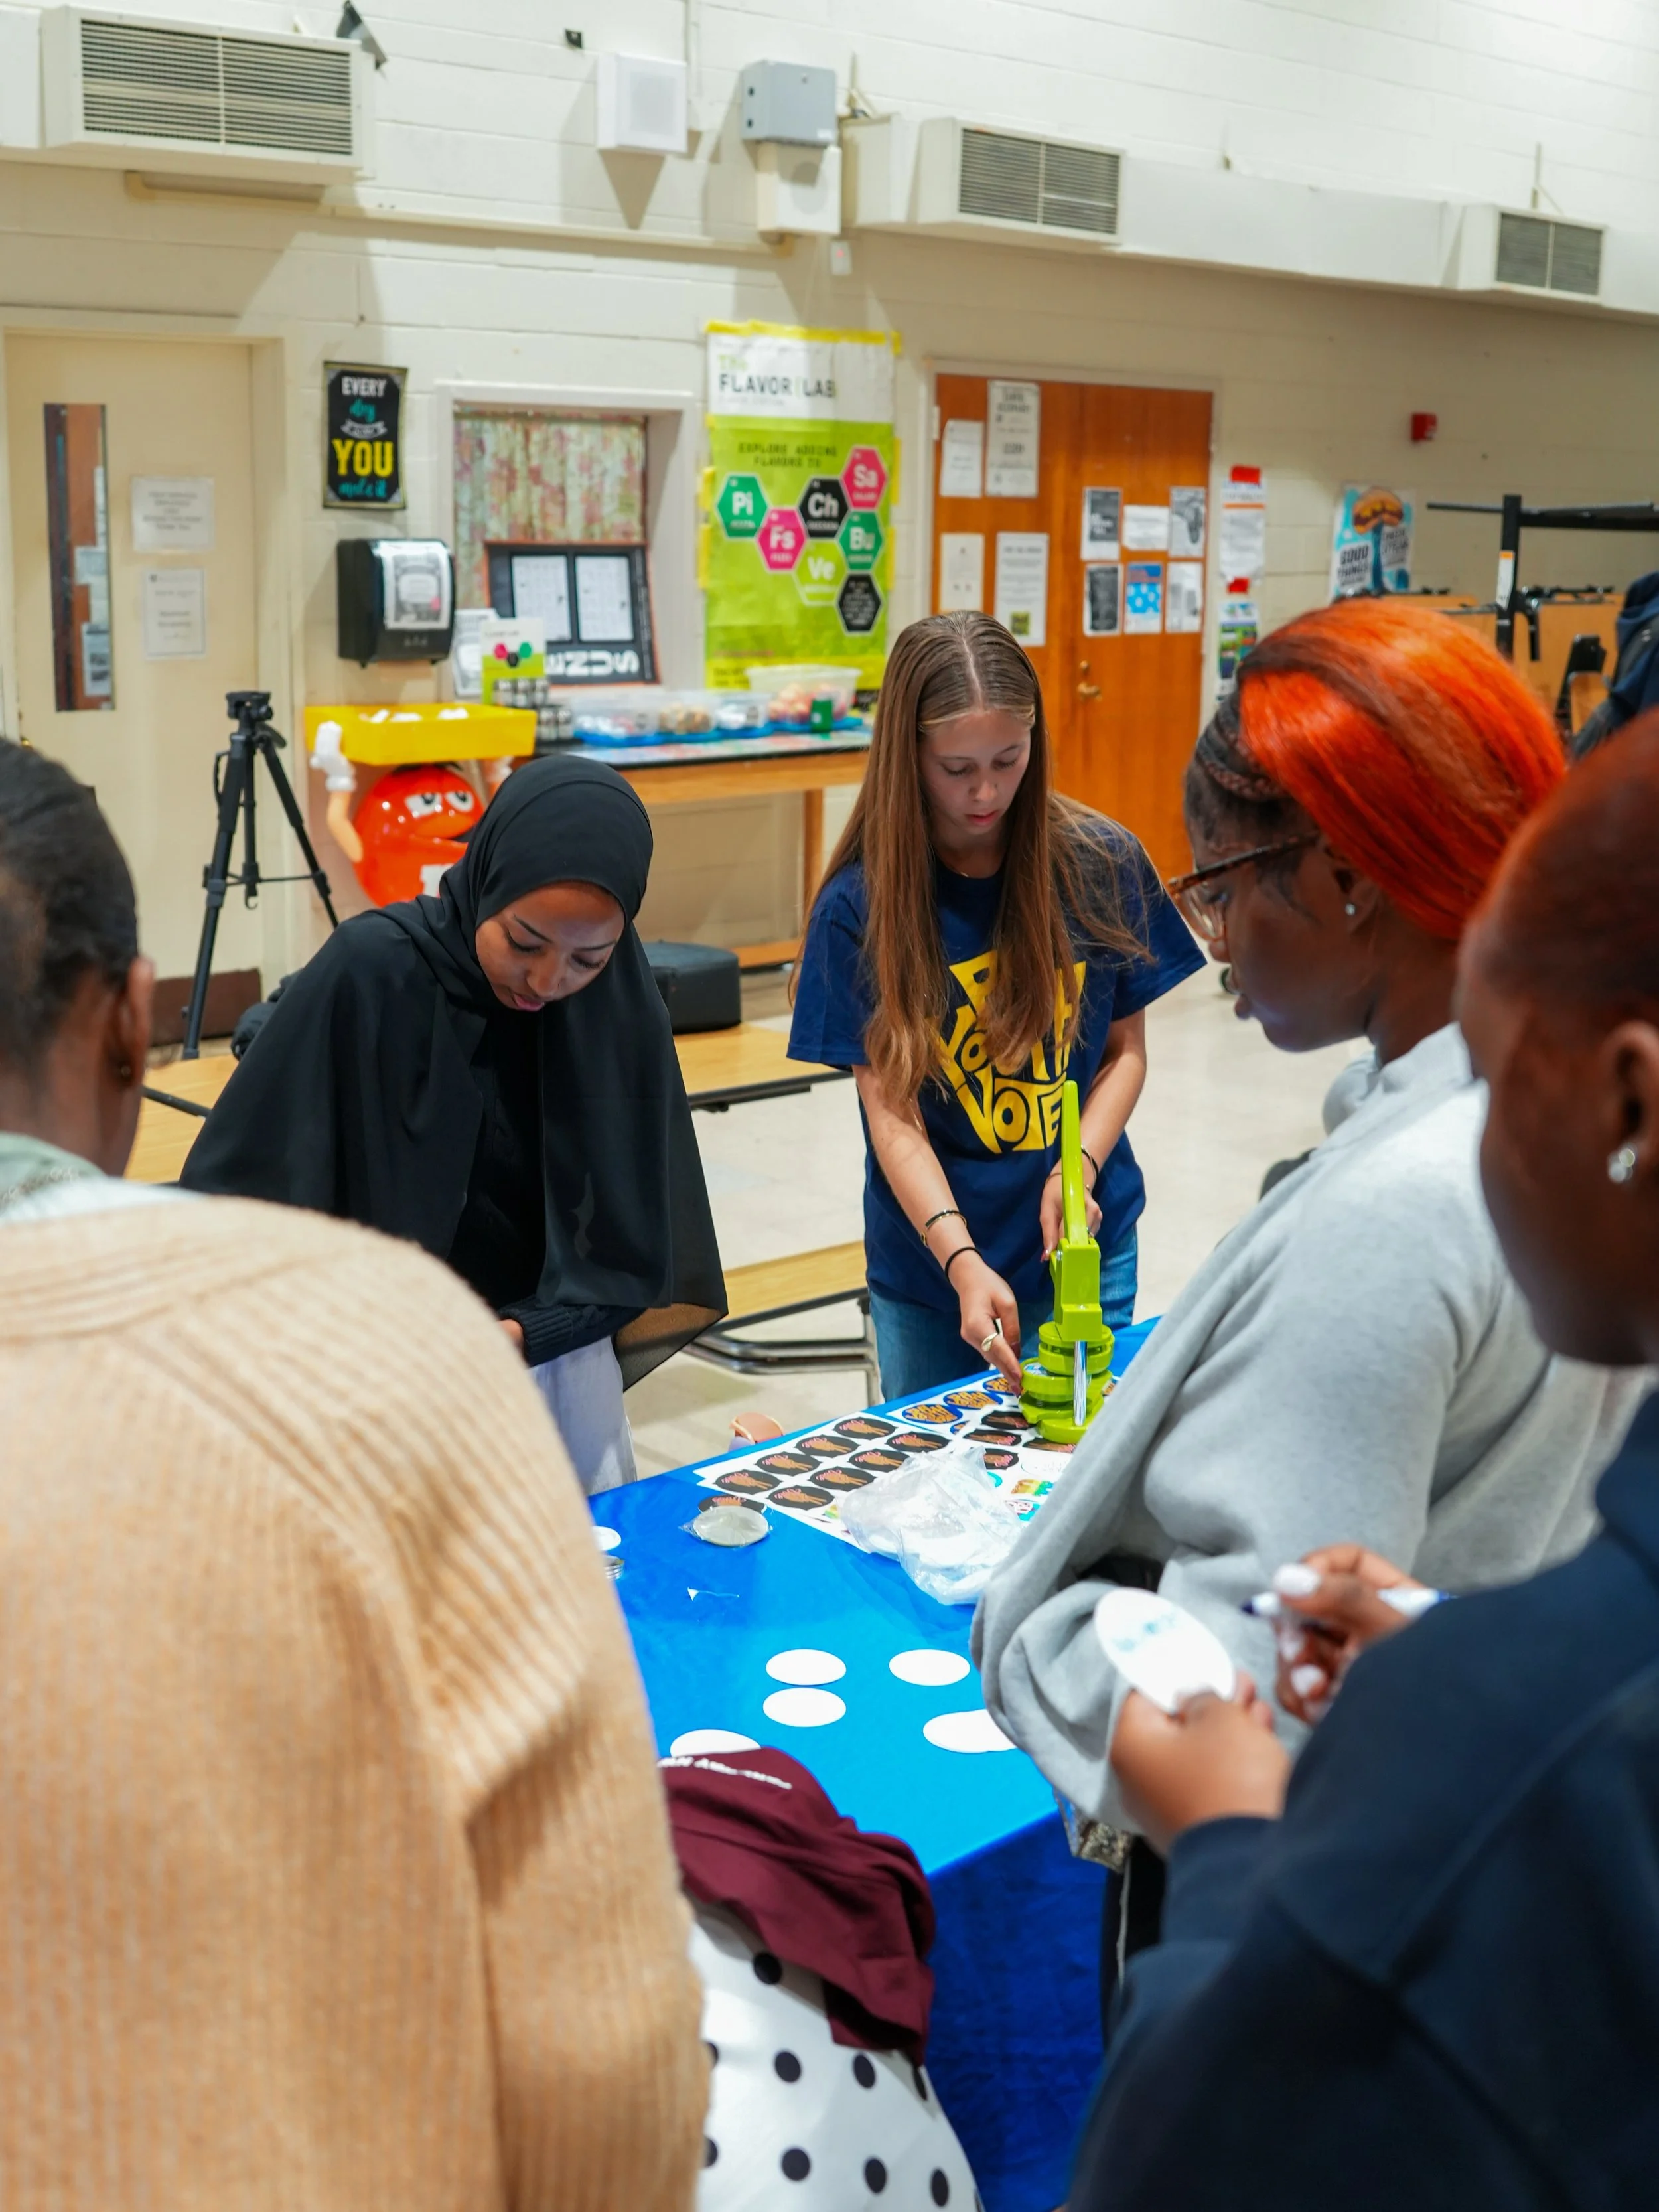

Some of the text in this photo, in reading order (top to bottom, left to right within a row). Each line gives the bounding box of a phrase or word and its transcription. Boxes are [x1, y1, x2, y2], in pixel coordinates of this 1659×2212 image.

[341, 376, 387, 397] EVERY
[719, 373, 792, 396] FLAVOR
[332, 439, 394, 477] YOU
[738, 442, 787, 455] EXPLORE
[853, 464, 878, 488] Sa
[732, 491, 753, 516] Pi
[808, 492, 839, 518] Ch
[770, 525, 795, 550] Fs
[850, 527, 875, 551] Bu
[1340, 544, 1369, 565] GOOD
[807, 557, 835, 581] Ve
[956, 1062, 1067, 1154] VOTE
